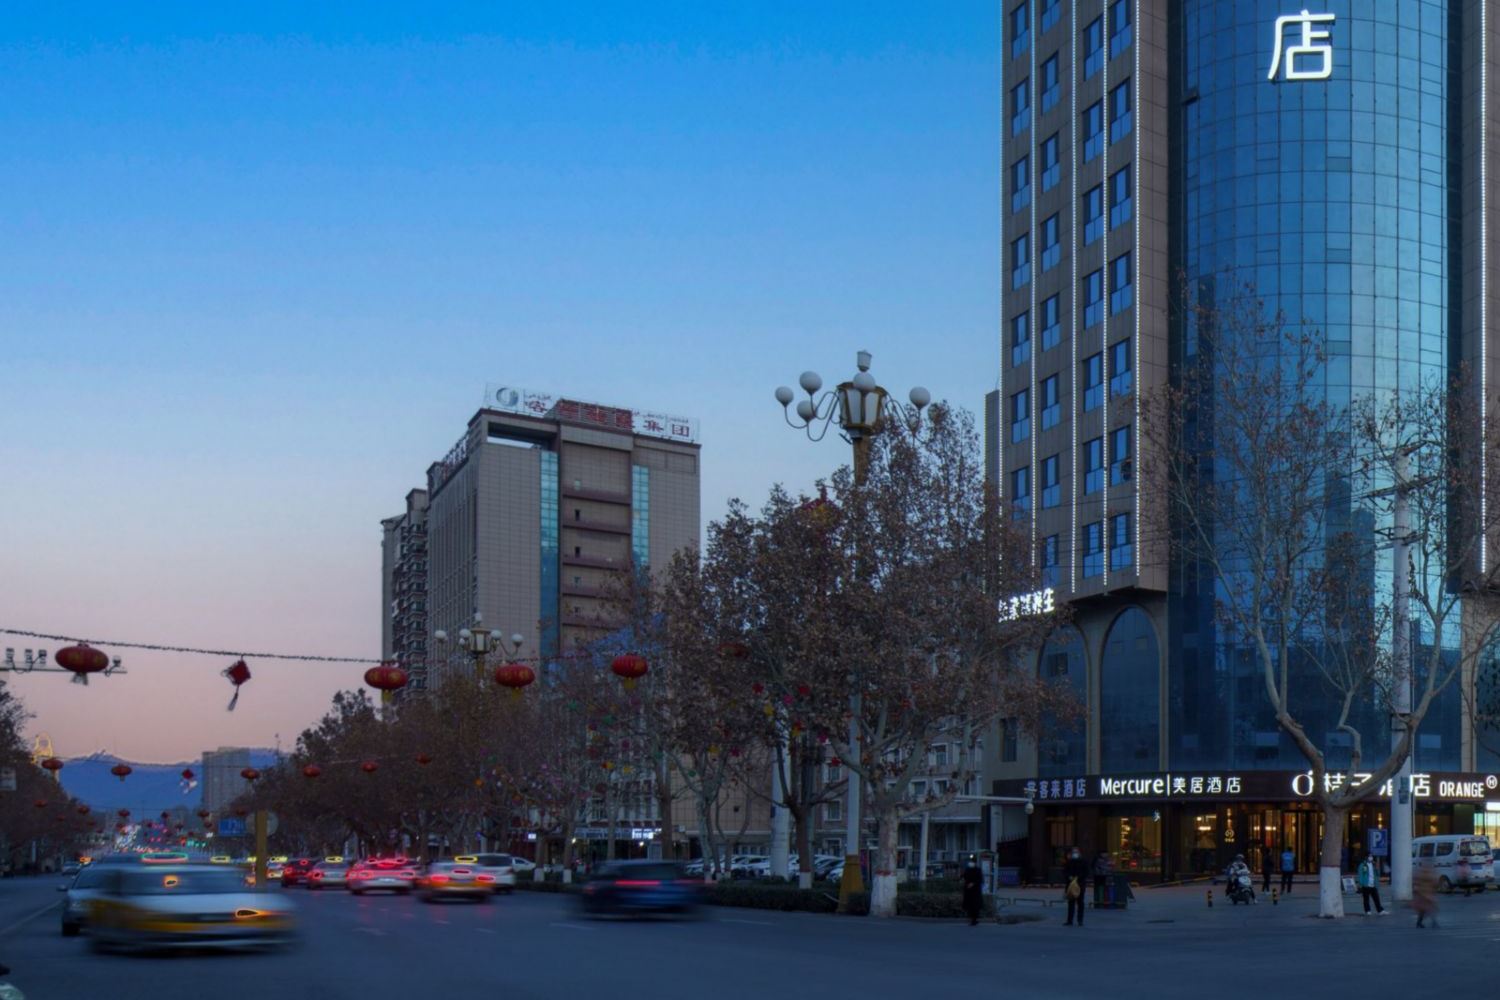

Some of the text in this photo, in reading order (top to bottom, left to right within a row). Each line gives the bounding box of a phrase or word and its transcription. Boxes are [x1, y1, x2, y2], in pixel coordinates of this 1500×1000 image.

[1100, 776, 1242, 796] Mercure 美居酒店
[1323, 772, 1431, 797] 桔子店
[1439, 781, 1485, 799] ORANGE
